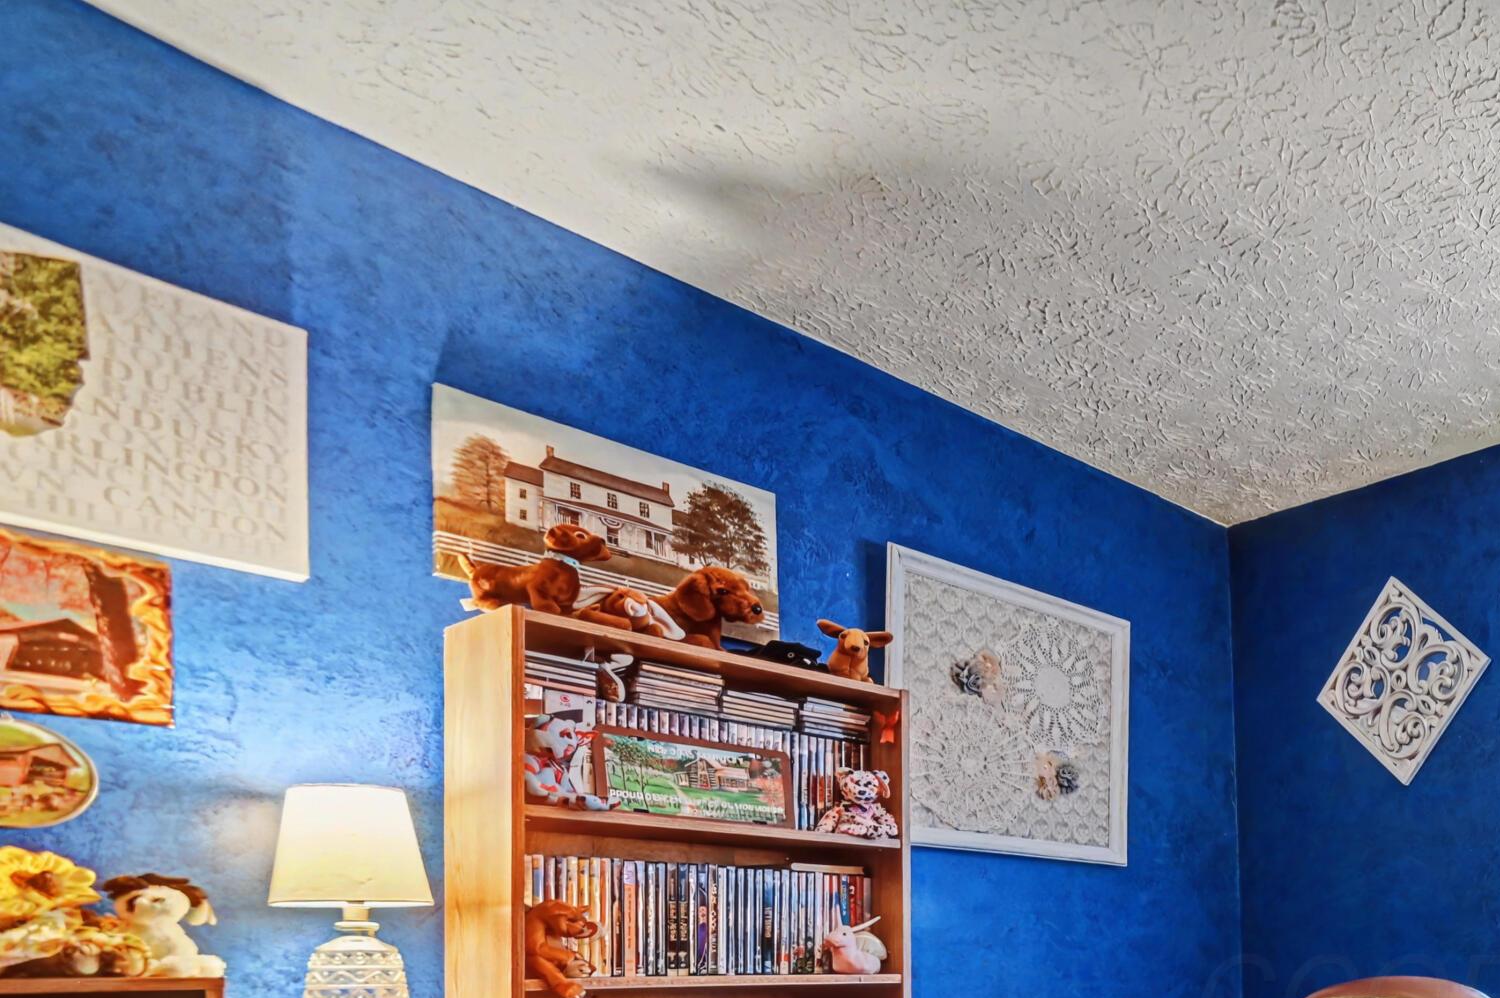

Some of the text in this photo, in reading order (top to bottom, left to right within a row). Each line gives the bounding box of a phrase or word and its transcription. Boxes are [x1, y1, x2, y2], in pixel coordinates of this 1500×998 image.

[96, 311, 288, 385] ATHENS
[102, 357, 288, 426] DUBLIN
[91, 396, 288, 465] NDUSKY
